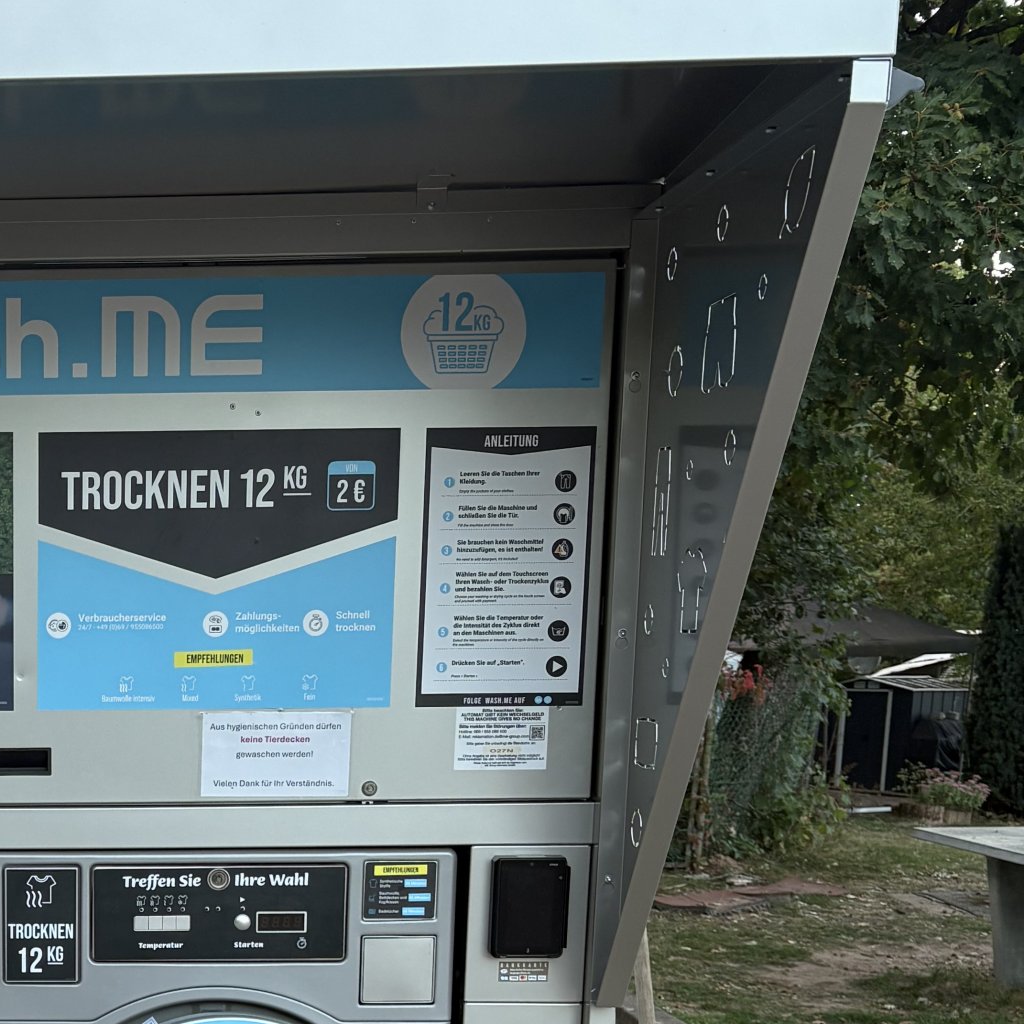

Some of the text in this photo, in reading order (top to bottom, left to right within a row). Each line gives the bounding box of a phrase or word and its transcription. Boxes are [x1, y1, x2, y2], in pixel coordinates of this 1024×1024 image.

[484, 435, 539, 447] ANLEITUNG
[345, 464, 358, 472] VON
[61, 465, 307, 510] TROCKNEN 12 KG
[337, 479, 365, 503] 2 €
[78, 613, 166, 622] Verbraucherservice
[235, 612, 281, 622] Zahlungs-
[336, 610, 369, 619] Schnell
[235, 624, 300, 633] möglichkeiten
[336, 623, 376, 631] trocknen
[186, 653, 244, 664] EMPFEHLUNGEN
[234, 694, 261, 702] Synthetik
[227, 723, 278, 732] hygienischen
[236, 751, 280, 759] gewaschen
[261, 779, 272, 787] für
[286, 779, 334, 787] Verständnis.
[123, 872, 309, 891] Treffen Sie Ihre Wahl
[8, 923, 74, 940] TROCKNEN
[138, 942, 184, 950] Temperatur
[18, 945, 64, 973] 12 KG
